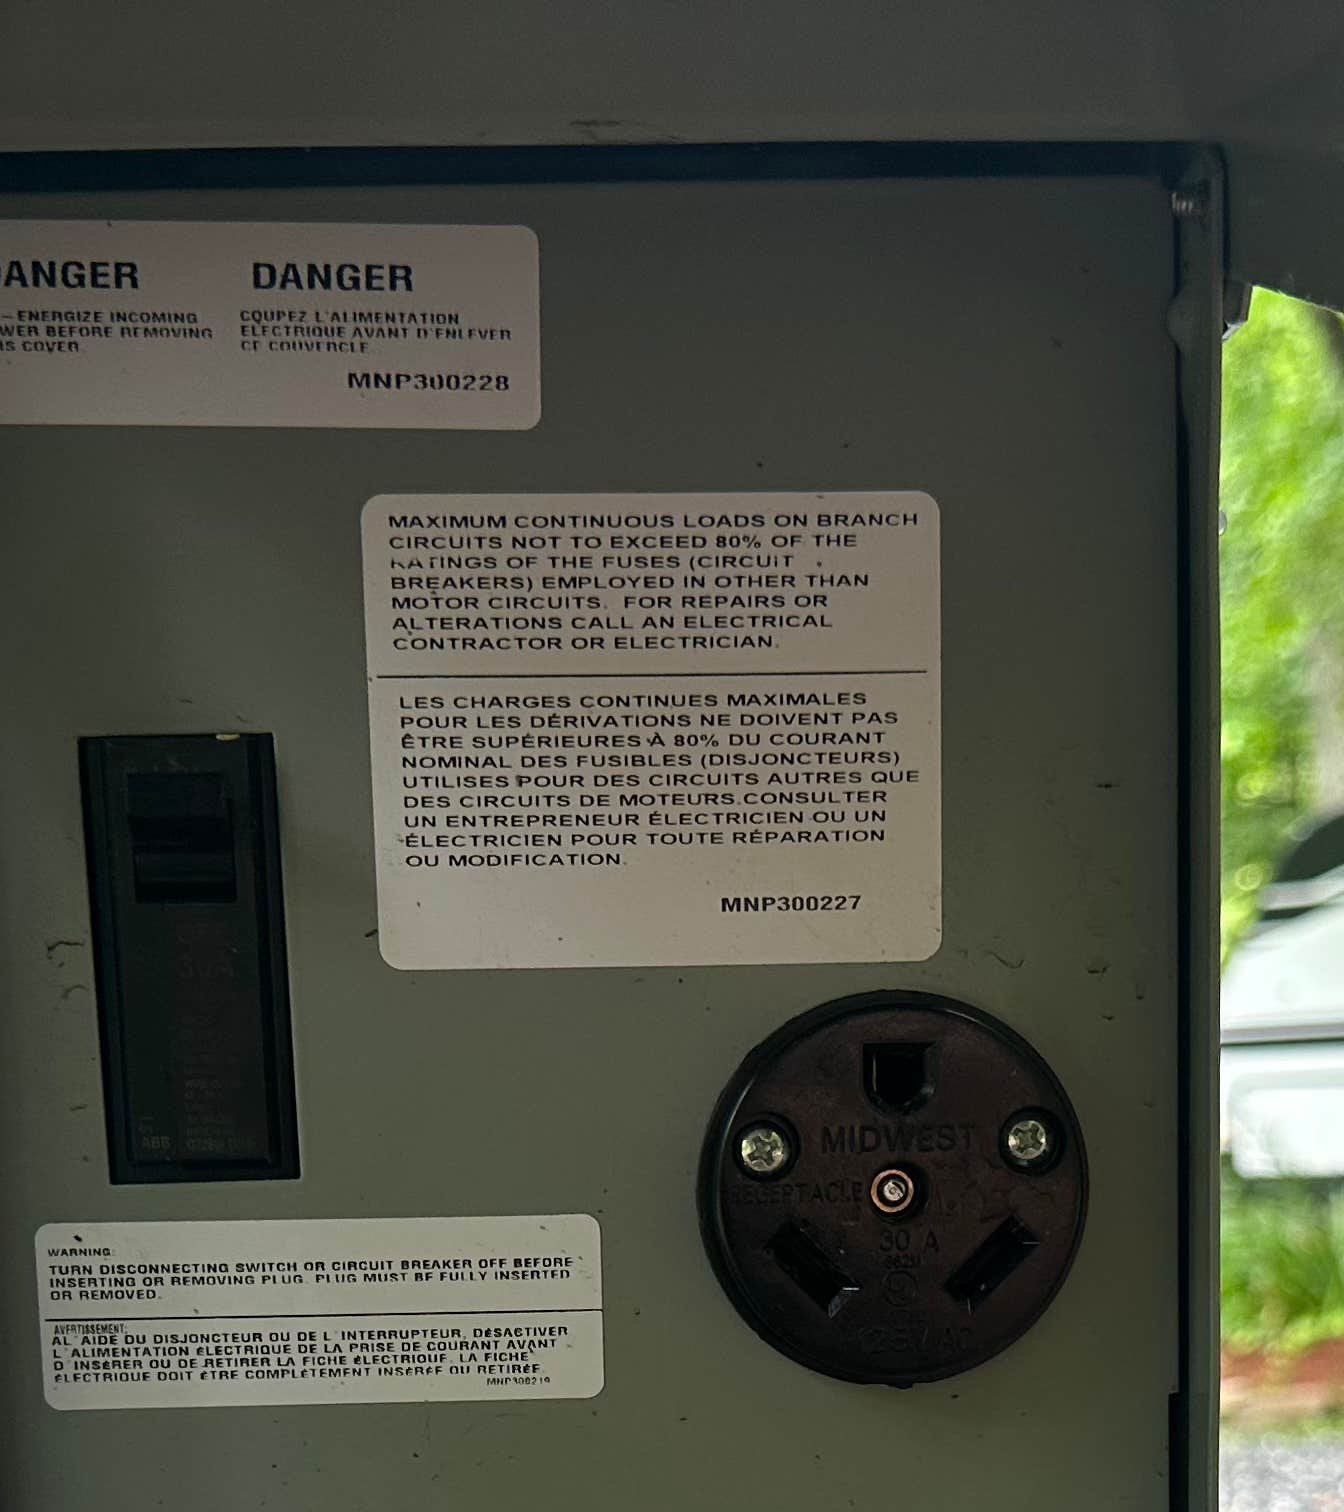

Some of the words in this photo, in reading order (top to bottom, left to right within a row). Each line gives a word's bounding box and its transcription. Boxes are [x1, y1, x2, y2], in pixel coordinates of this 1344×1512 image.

[252, 261, 413, 292] DANGER
[109, 311, 198, 324] INCOMING
[45, 324, 112, 338] BEFORE
[119, 326, 213, 339] REMOVING
[351, 325, 409, 339] AVANT
[347, 371, 509, 391] MNP300228
[387, 513, 507, 529] MAXIMUM
[513, 512, 674, 528] CONTINUOUS
[683, 513, 765, 528] LOADS
[773, 512, 807, 527] ON
[816, 512, 917, 527] BRANCH
[388, 534, 502, 550] CIRCUITS
[511, 535, 562, 550] NOT
[569, 535, 602, 549] TO
[609, 535, 707, 549] EXCEED
[715, 533, 761, 549] 80%
[770, 534, 805, 548] OF
[811, 533, 857, 547] THE
[505, 555, 538, 569] OF
[546, 555, 593, 569] THE
[601, 554, 680, 569] FUSES
[688, 554, 794, 570] (CIRCUIT
[390, 575, 533, 592] BREAKERS)
[541, 574, 675, 589] EMPLOYED
[683, 575, 705, 588] IN
[714, 573, 796, 588] OTHER
[804, 573, 868, 588] THAN
[391, 593, 479, 610] MOTOR
[623, 595, 672, 609] FOR
[681, 594, 785, 608] REPAIRS
[793, 593, 827, 608] OR
[392, 615, 562, 632] ALTERATIONS
[570, 615, 634, 629] CALL
[641, 615, 674, 629] AN
[683, 614, 832, 629] ELECTRICAL
[392, 634, 563, 651] CONTRACTOR
[570, 636, 605, 650] OR
[399, 695, 444, 709] LES
[453, 695, 571, 709] CHARGES
[579, 693, 718, 709] CONTINUES
[727, 692, 866, 707] MAXIMALES
[400, 715, 467, 729] POUR
[476, 715, 521, 729] LES
[529, 711, 691, 728] DÉRIVATIONS
[700, 713, 731, 726] NE
[739, 711, 843, 726] DOIVENT
[851, 711, 898, 724] PAS
[471, 731, 641, 749] SUPÉRIEURES
[645, 731, 666, 747] À
[673, 733, 719, 747] 80%
[728, 732, 760, 746] DU
[769, 731, 886, 746] COURANT
[401, 755, 512, 769] NOMINAL
[520, 755, 567, 768] DES
[576, 753, 692, 767] FUSIBLES
[700, 750, 900, 769] (DISJONCTEURS)
[402, 774, 509, 789] UTILISES
[514, 773, 585, 788] POUR
[593, 773, 640, 787] DES
[648, 772, 759, 787] CIRCUITS
[767, 770, 862, 785] AUTRES
[870, 770, 919, 784] QUE
[403, 795, 451, 808] DES
[459, 794, 571, 808] CIRCUITS
[579, 794, 611, 807] DE
[404, 815, 436, 828] UN
[445, 813, 640, 828] ENTREPRENEUR
[648, 809, 803, 825] ÉLECTRICIEN
[807, 810, 845, 823] OU
[854, 809, 885, 823] UN
[405, 830, 562, 848] ÉLECTRICIEN
[571, 832, 637, 848] POUR
[645, 831, 724, 845] TOUTE
[732, 827, 885, 844] RÉPARATION
[404, 854, 439, 867] OU
[720, 894, 861, 912] MNP300227
[821, 1124, 976, 1154] MIDWEST
[879, 1229, 911, 1253] 30
[920, 1230, 941, 1254] A
[48, 1264, 93, 1276] TURN
[99, 1262, 229, 1275] DISCONNECTING
[235, 1261, 297, 1273] SWITCH
[303, 1261, 326, 1271] OR
[331, 1260, 394, 1271] CIRCUIT
[400, 1258, 472, 1270] BREAKER
[478, 1258, 507, 1269] OFF
[513, 1256, 574, 1270] BEFORE
[49, 1276, 136, 1288] INSERTING
[142, 1276, 165, 1287] OR
[170, 1274, 255, 1286] REMOVING
[315, 1273, 357, 1284] PLUG
[363, 1272, 408, 1283] MUST
[414, 1271, 433, 1282] BE
[439, 1270, 487, 1281] FULLY
[494, 1269, 570, 1280] INSERTED
[49, 1290, 72, 1301] OR
[123, 1332, 146, 1345] DU
[152, 1332, 263, 1344] DISJONCTEUR
[268, 1331, 290, 1342] OU
[296, 1331, 317, 1341] DE
[297, 1343, 317, 1354] DE
[323, 1343, 343, 1353] LA
[349, 1341, 395, 1353] PRISE
[401, 1341, 422, 1352] DE
[426, 1338, 500, 1352] COURANT
[505, 1338, 557, 1351] AVANT
[148, 1358, 171, 1369] OU
[177, 1357, 195, 1369] DE
[198, 1356, 272, 1368] RETIRER
[276, 1356, 295, 1366] LA
[302, 1355, 347, 1366] FICHE
[459, 1352, 477, 1362] LA
[483, 1350, 532, 1362] FICHE
[157, 1370, 193, 1381] DOIT
[449, 1365, 470, 1374] OU
